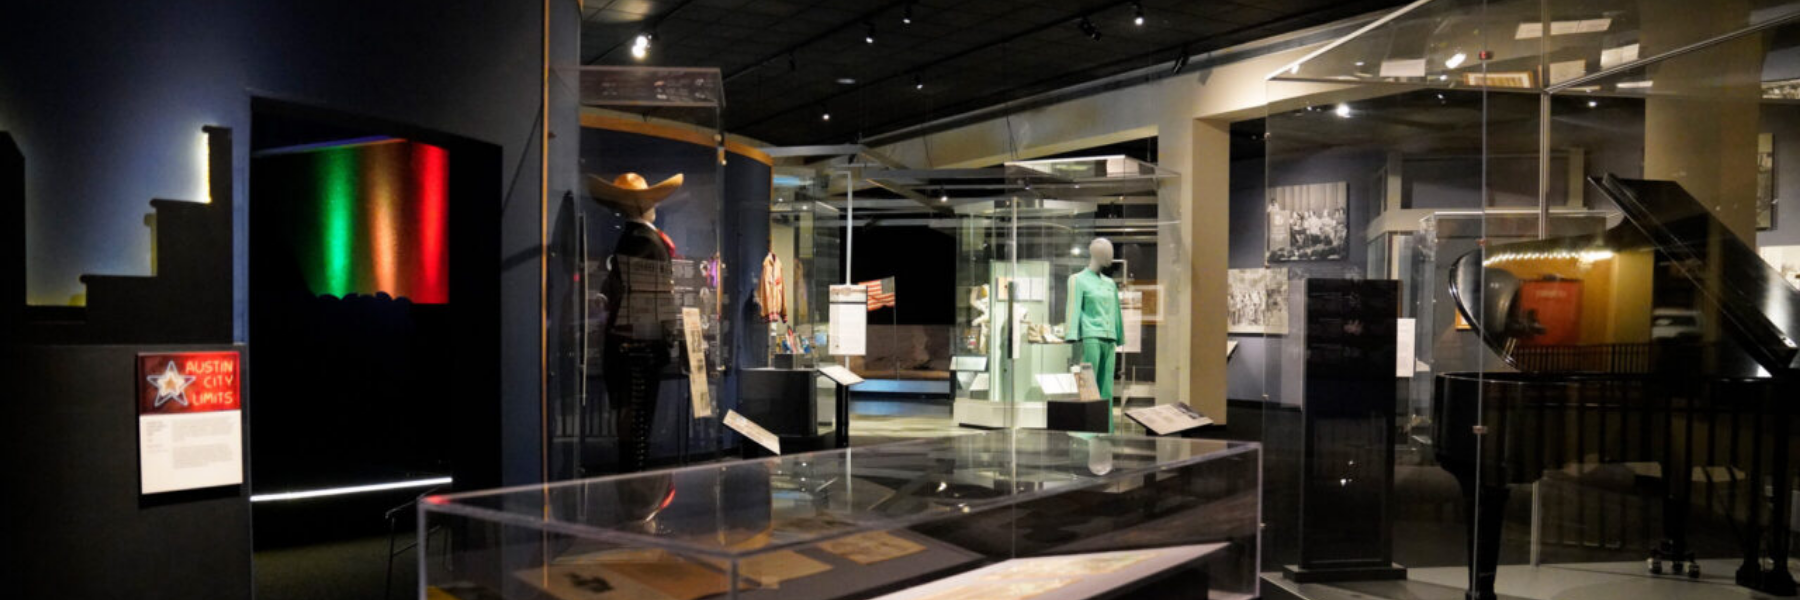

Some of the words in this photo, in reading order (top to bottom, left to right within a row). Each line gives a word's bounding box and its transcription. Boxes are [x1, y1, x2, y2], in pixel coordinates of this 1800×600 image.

[185, 360, 233, 374] AUSTIN
[203, 375, 233, 389] CITY
[192, 391, 233, 405] LIMITS
